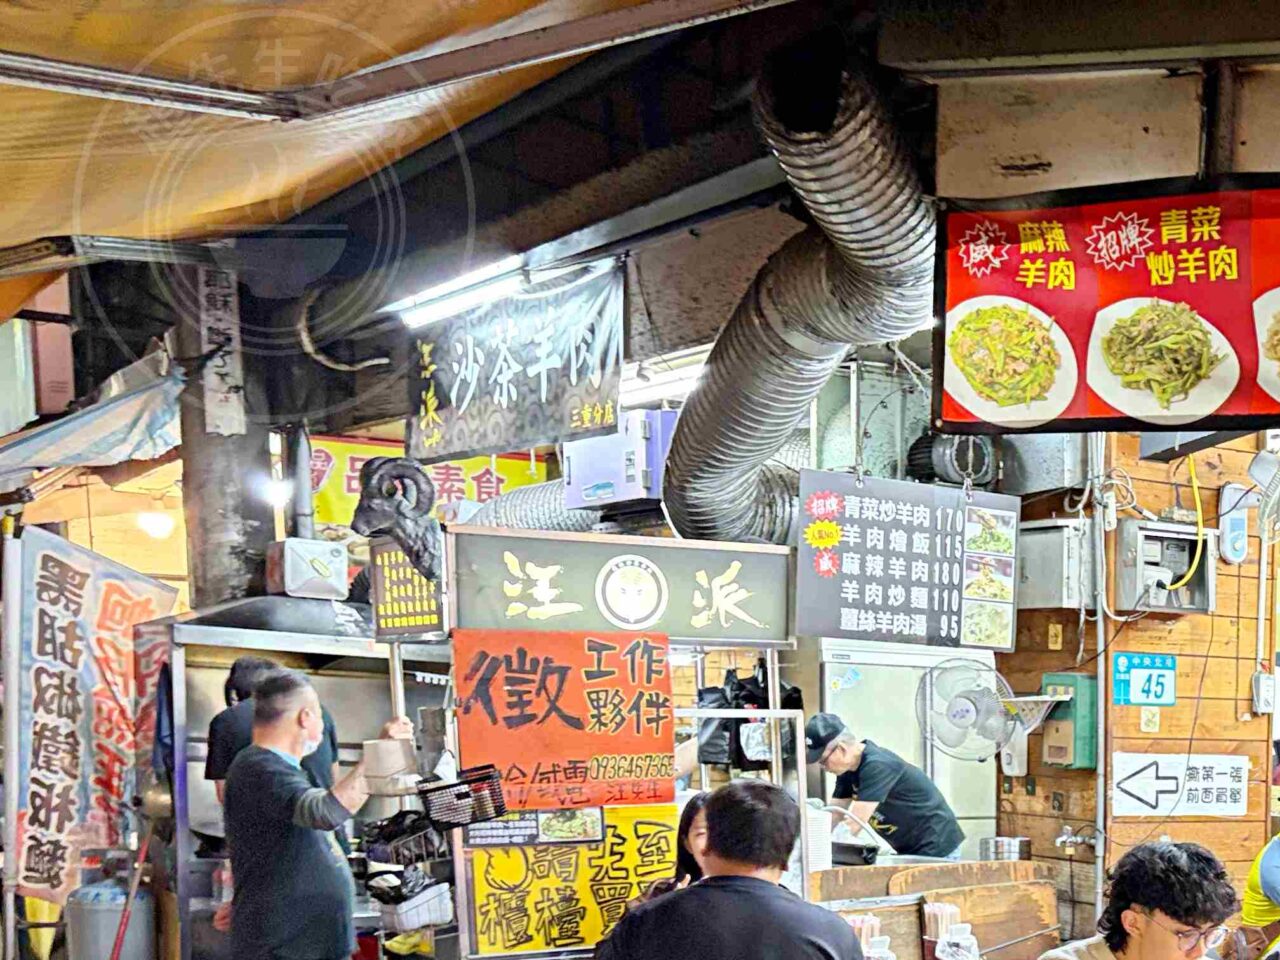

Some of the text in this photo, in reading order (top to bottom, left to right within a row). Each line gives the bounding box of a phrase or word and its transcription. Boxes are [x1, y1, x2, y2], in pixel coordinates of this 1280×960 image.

[1018, 220, 1071, 254] 麻辣
[1098, 222, 1145, 262] 招牌
[1159, 206, 1222, 243] 青菜
[1015, 257, 1077, 291] 羊肉
[1146, 244, 1240, 287] 炒羊肉
[450, 305, 605, 416] 沙茶羊肉
[570, 401, 615, 429] 三重分店
[844, 494, 963, 533] 青菜炒羊肉 170
[842, 523, 963, 559] 羊肉燴飯 115
[842, 551, 960, 586] 麻辣羊肉 180
[503, 551, 584, 619] 汪
[690, 560, 771, 630] 派
[840, 580, 960, 613] 羊肉炒麵 110
[840, 607, 959, 638] 薑絲羊肉湯 95
[584, 638, 666, 685] 工作
[459, 646, 586, 731] 徵
[1141, 673, 1166, 699] 45
[585, 688, 673, 736] 夥伴
[479, 879, 656, 949] 櫃檯買
